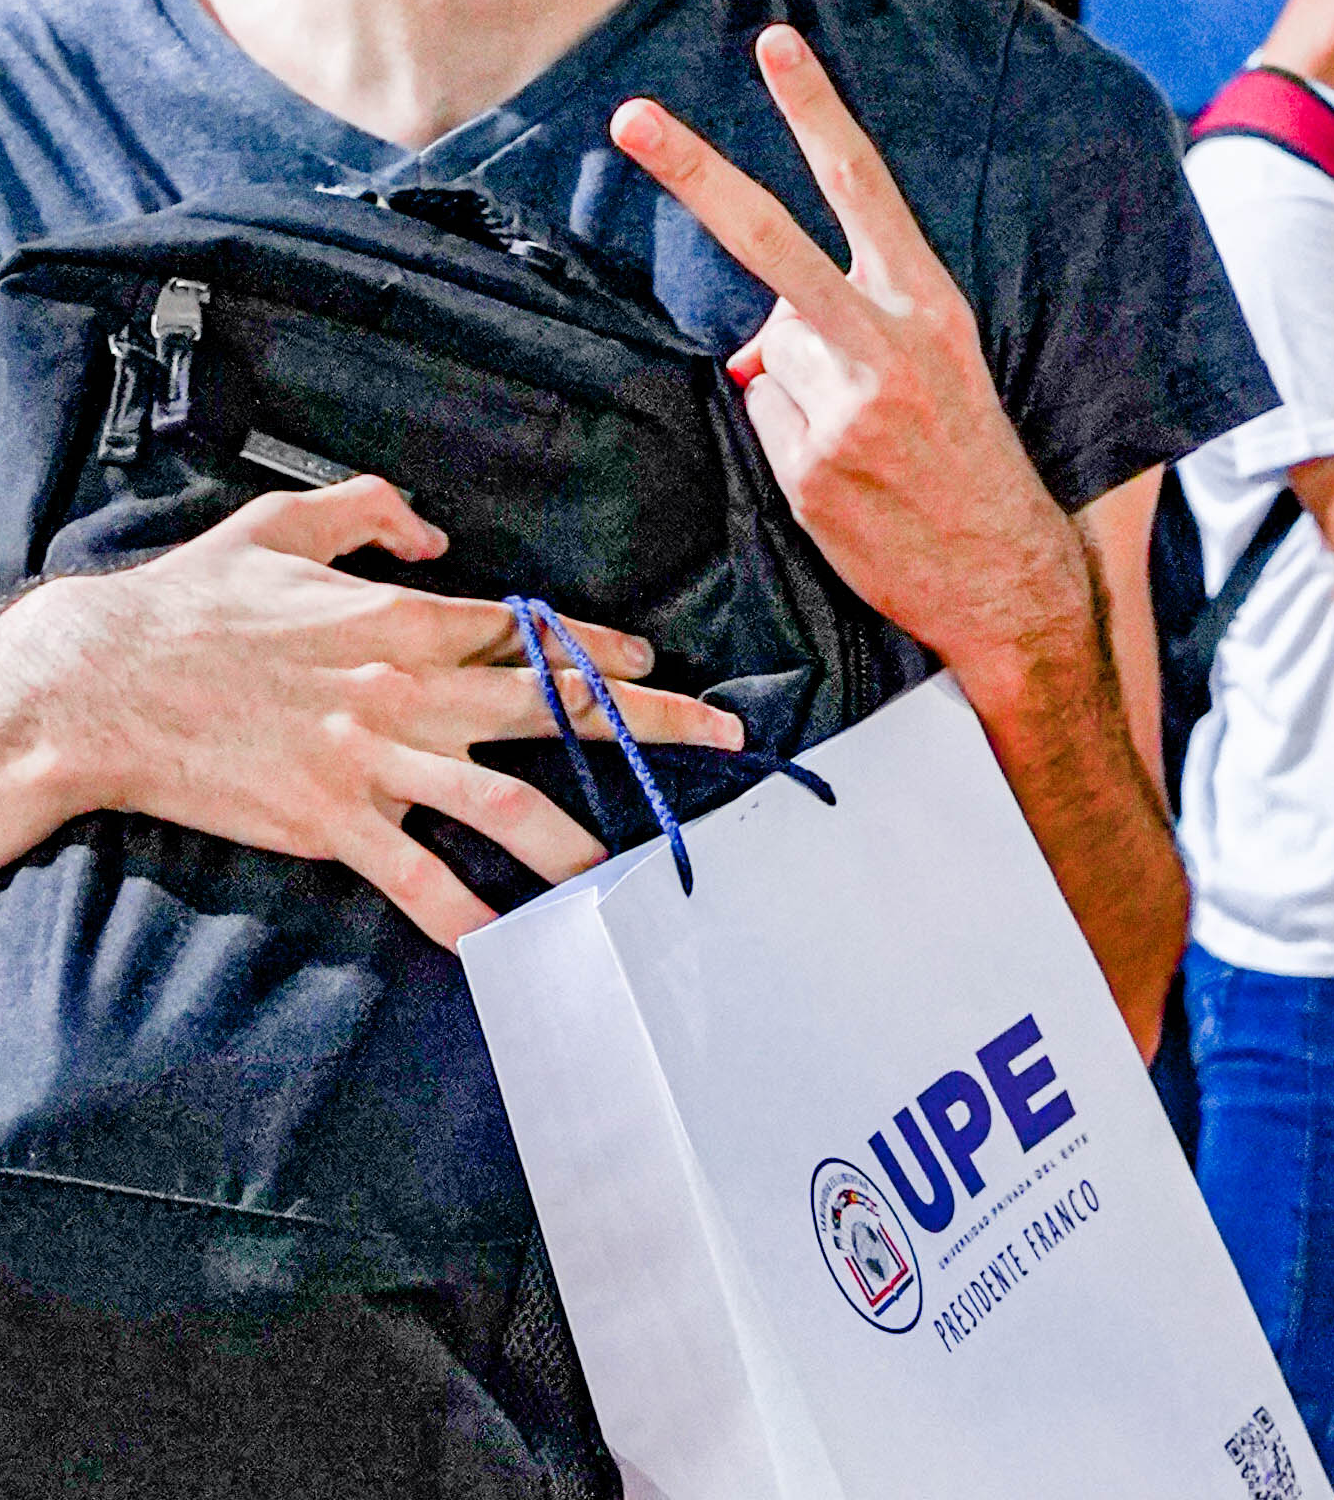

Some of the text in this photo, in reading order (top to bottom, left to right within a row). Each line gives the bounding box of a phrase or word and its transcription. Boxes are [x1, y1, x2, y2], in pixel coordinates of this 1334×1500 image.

[868, 1013, 1076, 1234] UPE
[1034, 1160, 1057, 1180] DEL
[933, 1179, 1099, 1353] PRESIDENTE FRANCO
